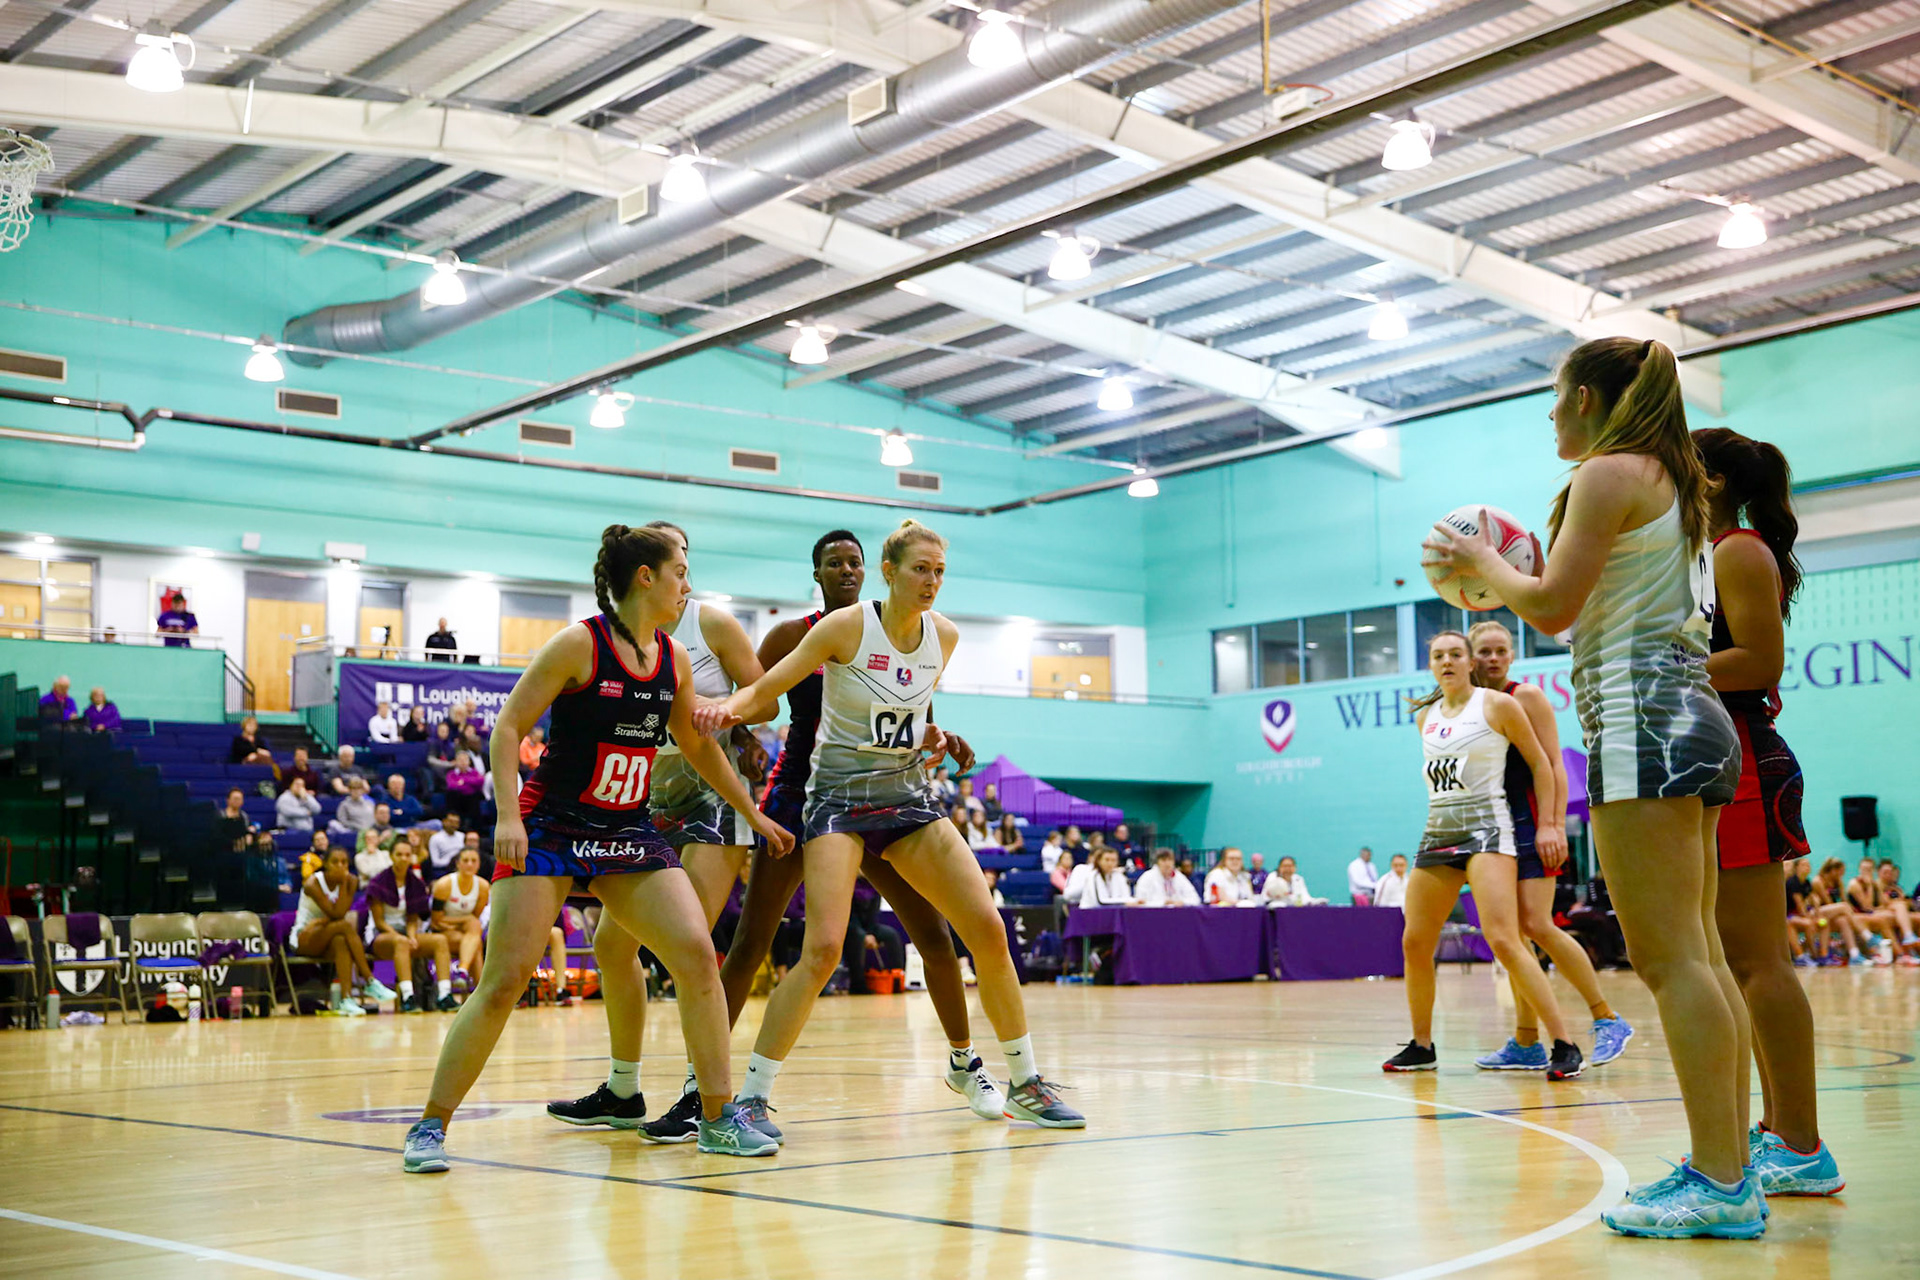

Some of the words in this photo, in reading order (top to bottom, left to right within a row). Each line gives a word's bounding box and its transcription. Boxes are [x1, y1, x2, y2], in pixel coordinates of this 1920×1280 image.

[418, 683, 510, 707] Loughboro
[1334, 686, 1427, 730] WHE
[1777, 634, 1916, 691] EGIN
[614, 727, 655, 739] Strathclyde
[872, 711, 914, 749] GA
[592, 753, 648, 805] GD
[1427, 758, 1465, 793] WA
[572, 840, 645, 861] Vitality
